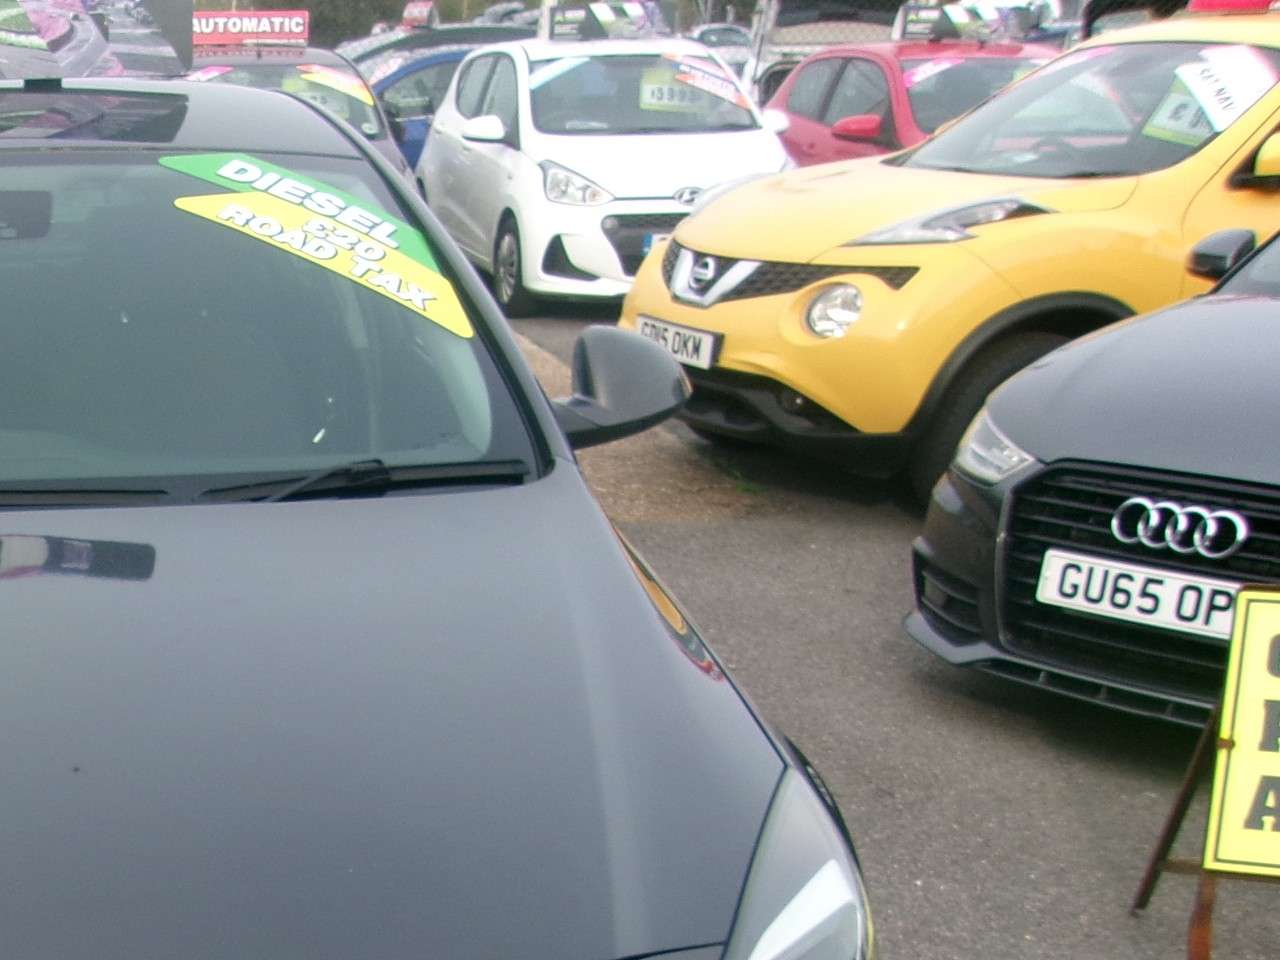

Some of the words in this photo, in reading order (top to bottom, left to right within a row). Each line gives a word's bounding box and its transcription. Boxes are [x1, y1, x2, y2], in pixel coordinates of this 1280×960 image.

[192, 17, 305, 33] AUTOMATIC
[216, 159, 400, 249] DIESEL
[216, 204, 337, 260] ROAD
[350, 255, 437, 312] TAX
[302, 218, 387, 262] £20
[672, 331, 703, 361] OKM
[1058, 563, 1164, 615] GU65
